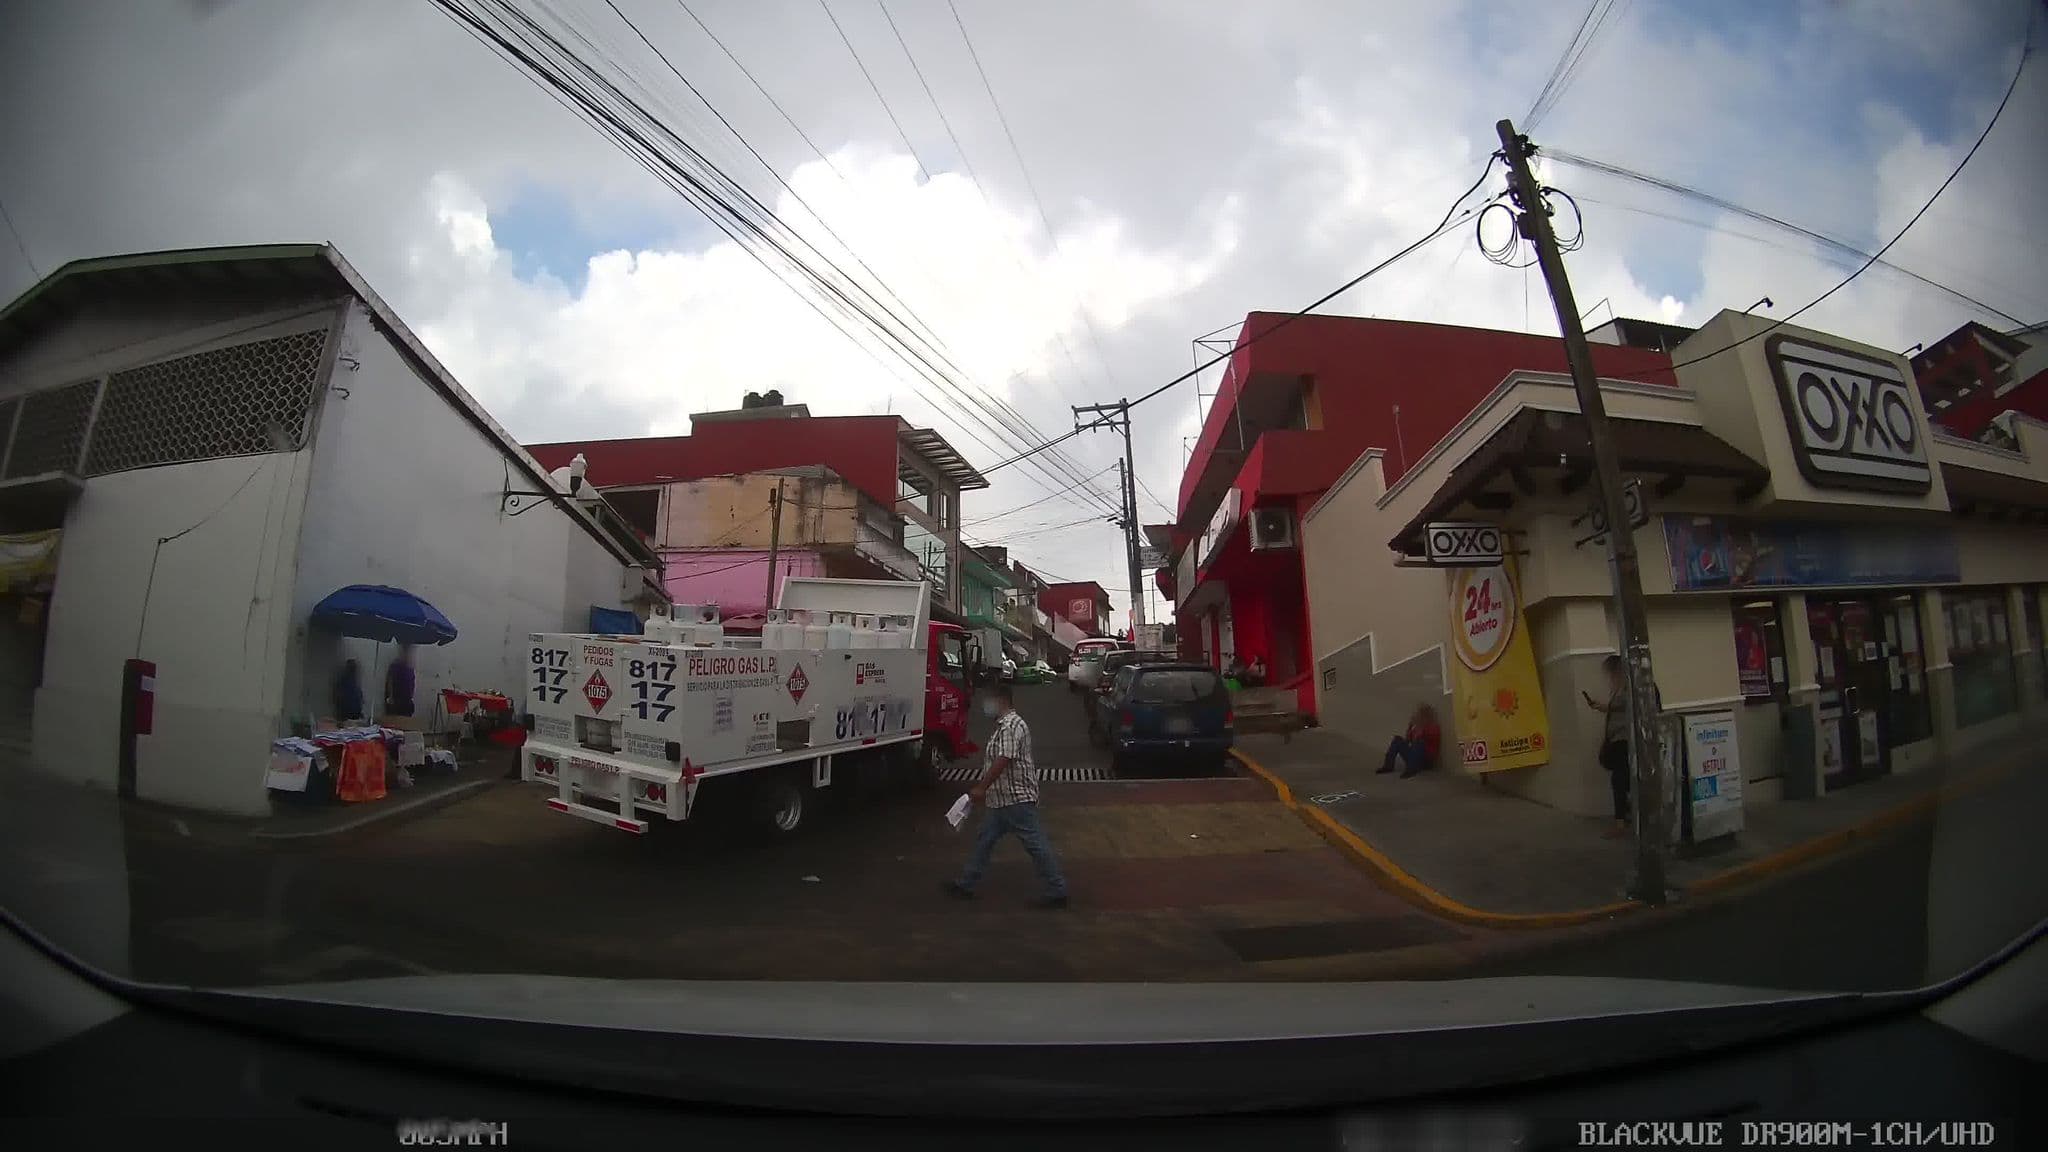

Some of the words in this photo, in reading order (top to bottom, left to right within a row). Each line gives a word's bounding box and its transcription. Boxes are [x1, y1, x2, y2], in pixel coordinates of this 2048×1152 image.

[1797, 372, 1915, 453] OXXO
[1433, 529, 1498, 556] OXXO
[1464, 578, 1490, 622] 24
[1469, 619, 1497, 637] Abierto
[531, 648, 569, 667] 817
[583, 645, 614, 657] PEDIDOS
[583, 656, 590, 664] Y
[590, 656, 614, 667] FUGAS
[629, 660, 677, 681] 817
[688, 657, 736, 676] PELIGRO
[738, 657, 759, 674] GAS
[532, 666, 568, 685] 17
[532, 685, 568, 704] 17
[588, 684, 608, 699] 1075
[631, 681, 676, 701] 17
[631, 701, 676, 722] 17
